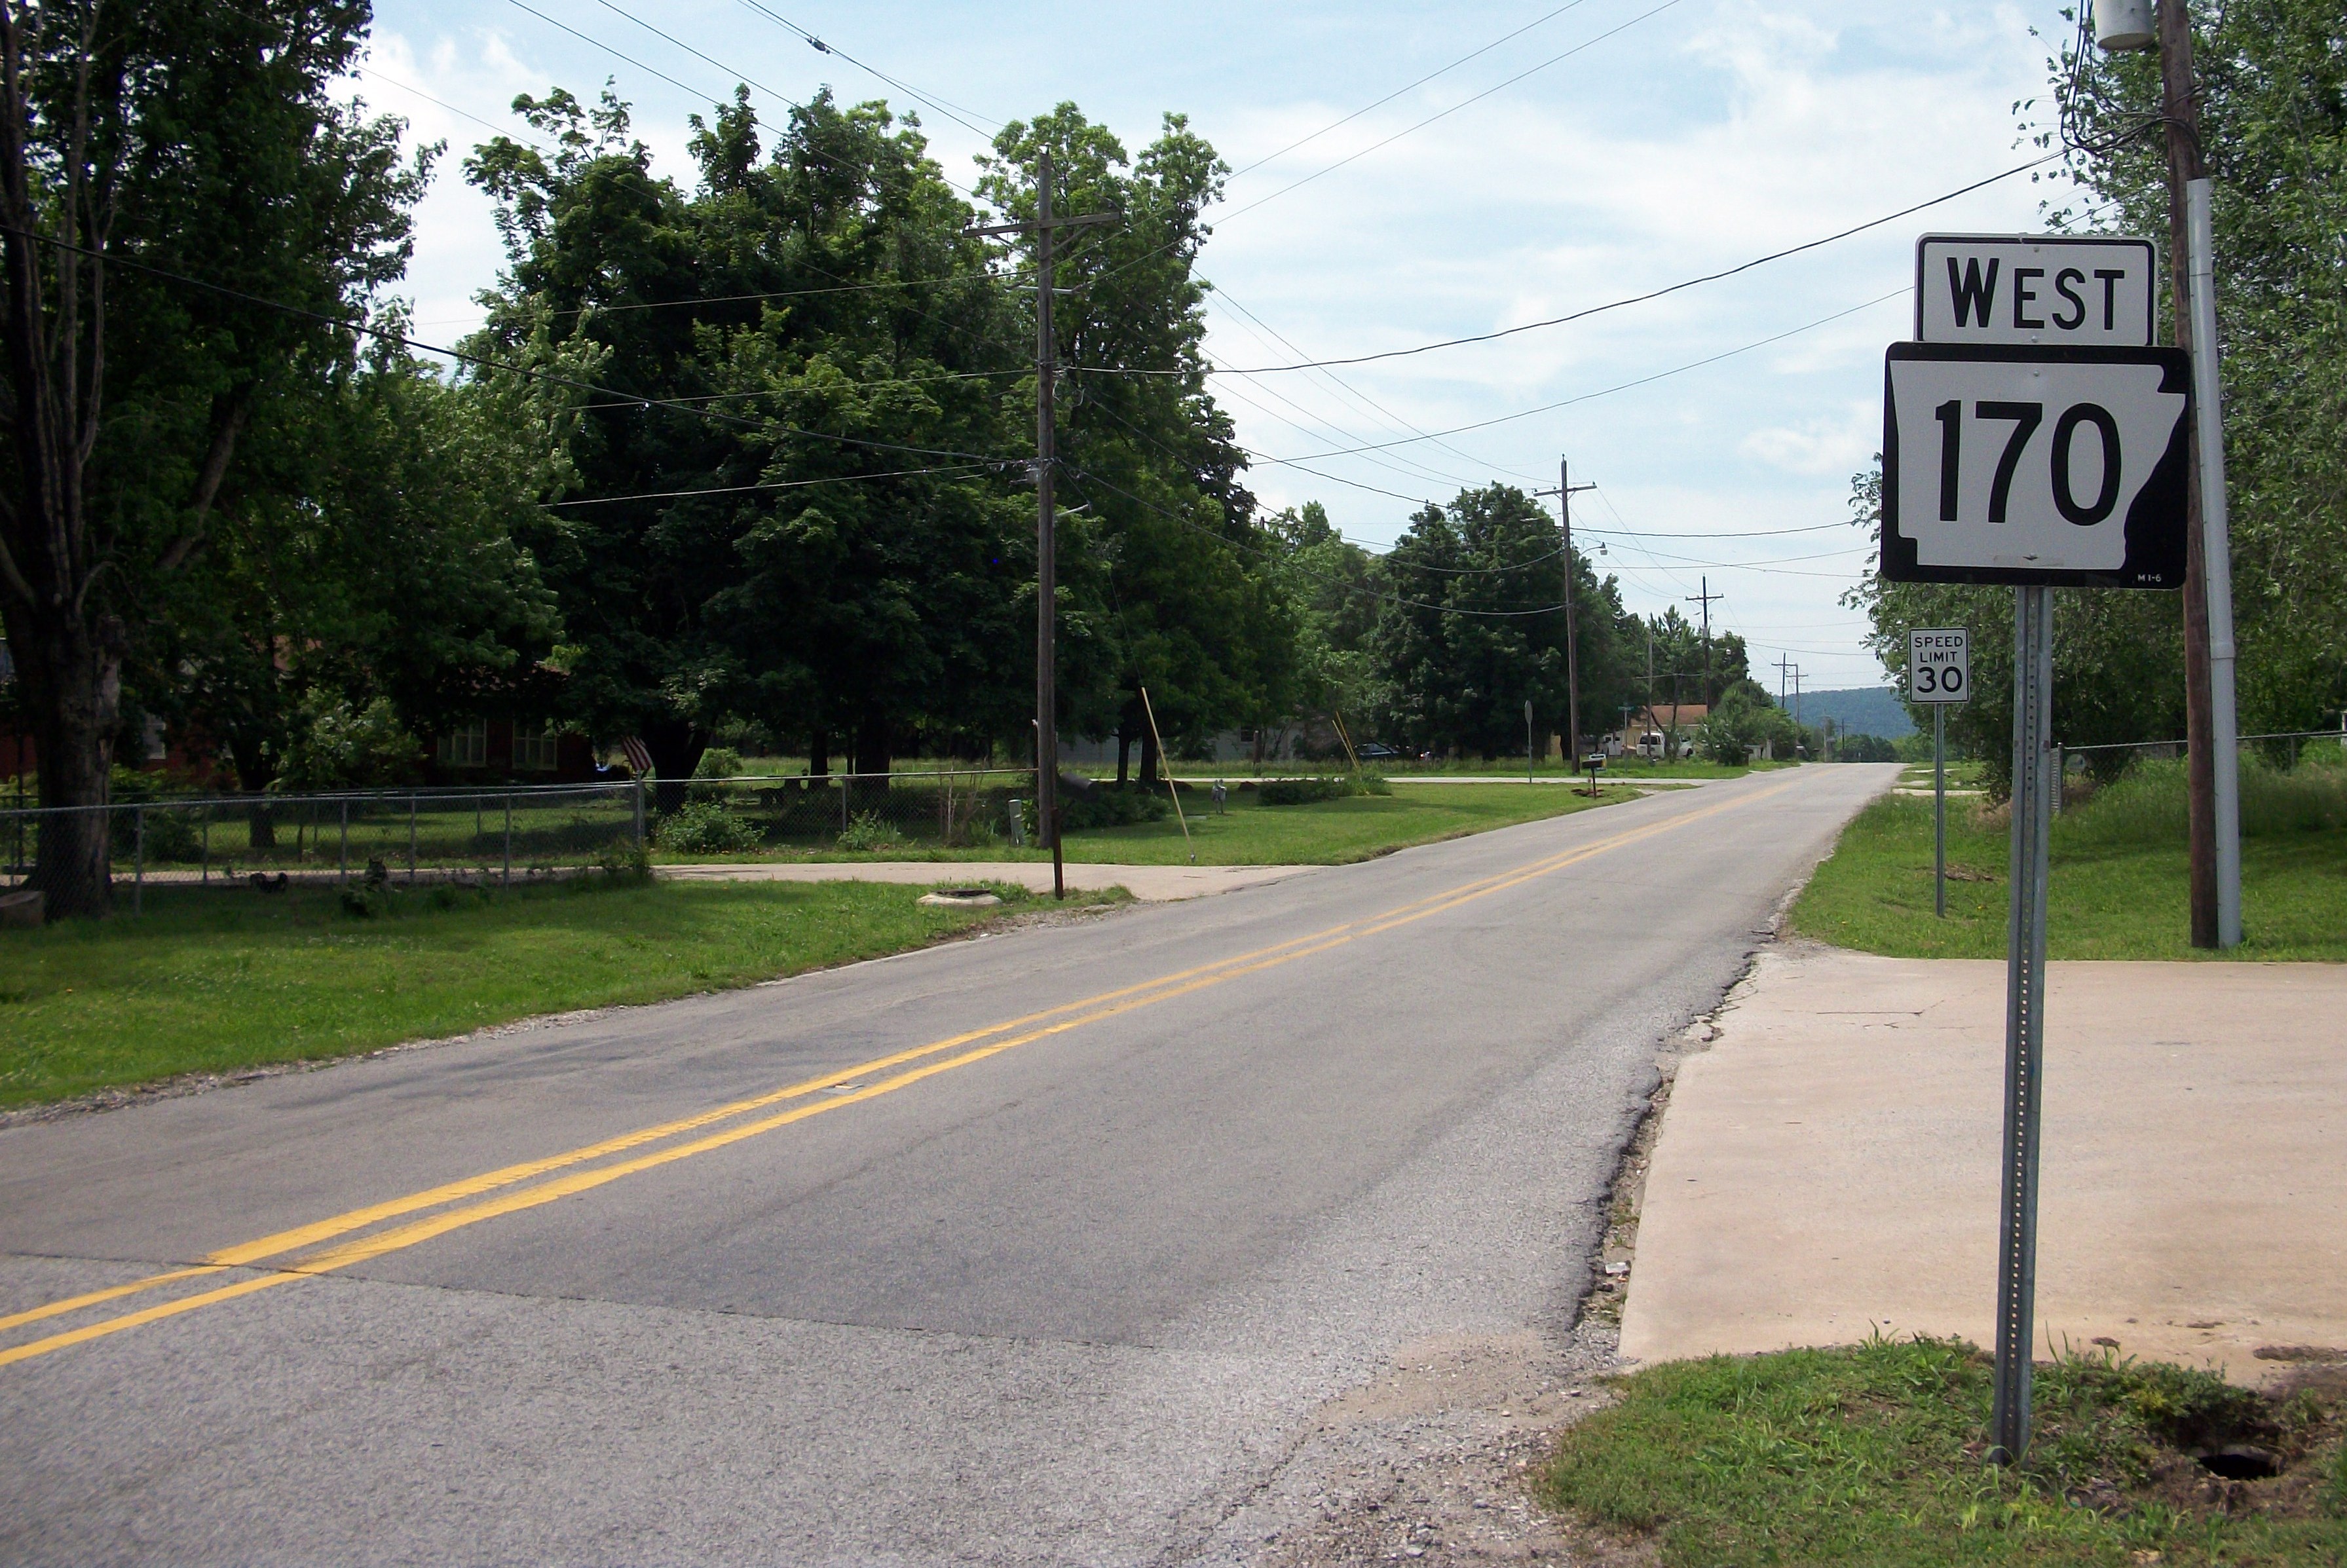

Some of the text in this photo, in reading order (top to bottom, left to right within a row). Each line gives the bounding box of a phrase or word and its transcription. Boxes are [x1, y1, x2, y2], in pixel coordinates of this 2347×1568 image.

[1947, 257, 2125, 331] WEST
[1935, 400, 2122, 526] 170
[1915, 636, 1963, 648] SPEED
[1919, 652, 1957, 663] LIMIT
[1917, 666, 1962, 693] 30
